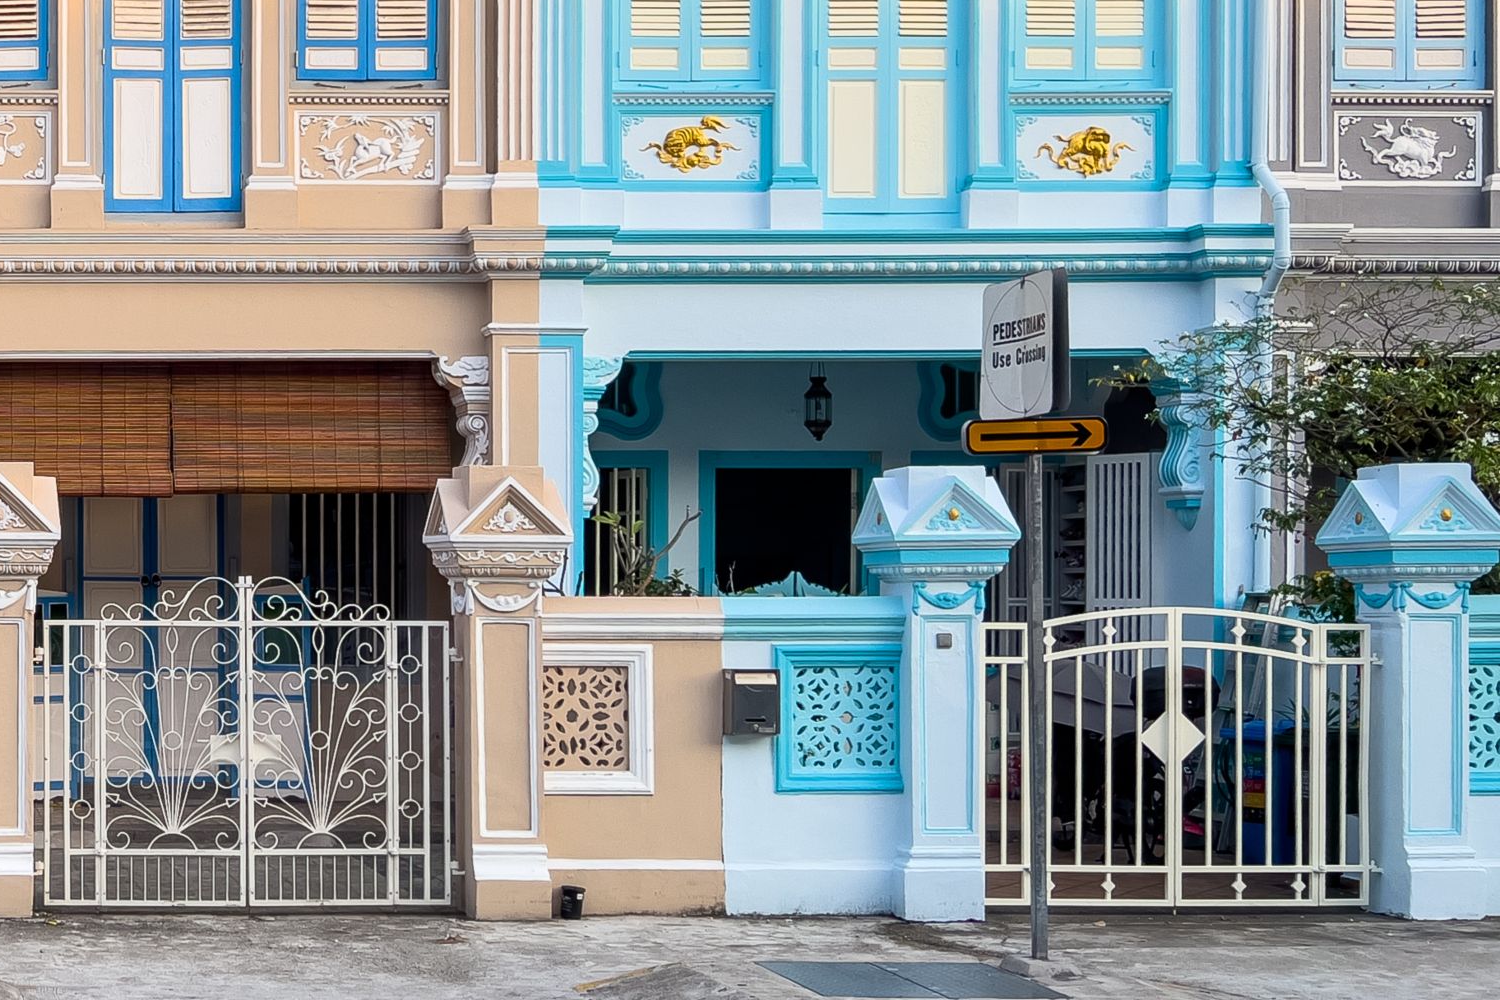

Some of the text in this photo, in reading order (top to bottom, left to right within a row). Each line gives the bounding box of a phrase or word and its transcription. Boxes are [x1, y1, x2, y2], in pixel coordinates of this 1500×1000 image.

[993, 313, 1046, 342] PEDESTRIANS
[992, 344, 1046, 369] Use Crossing
